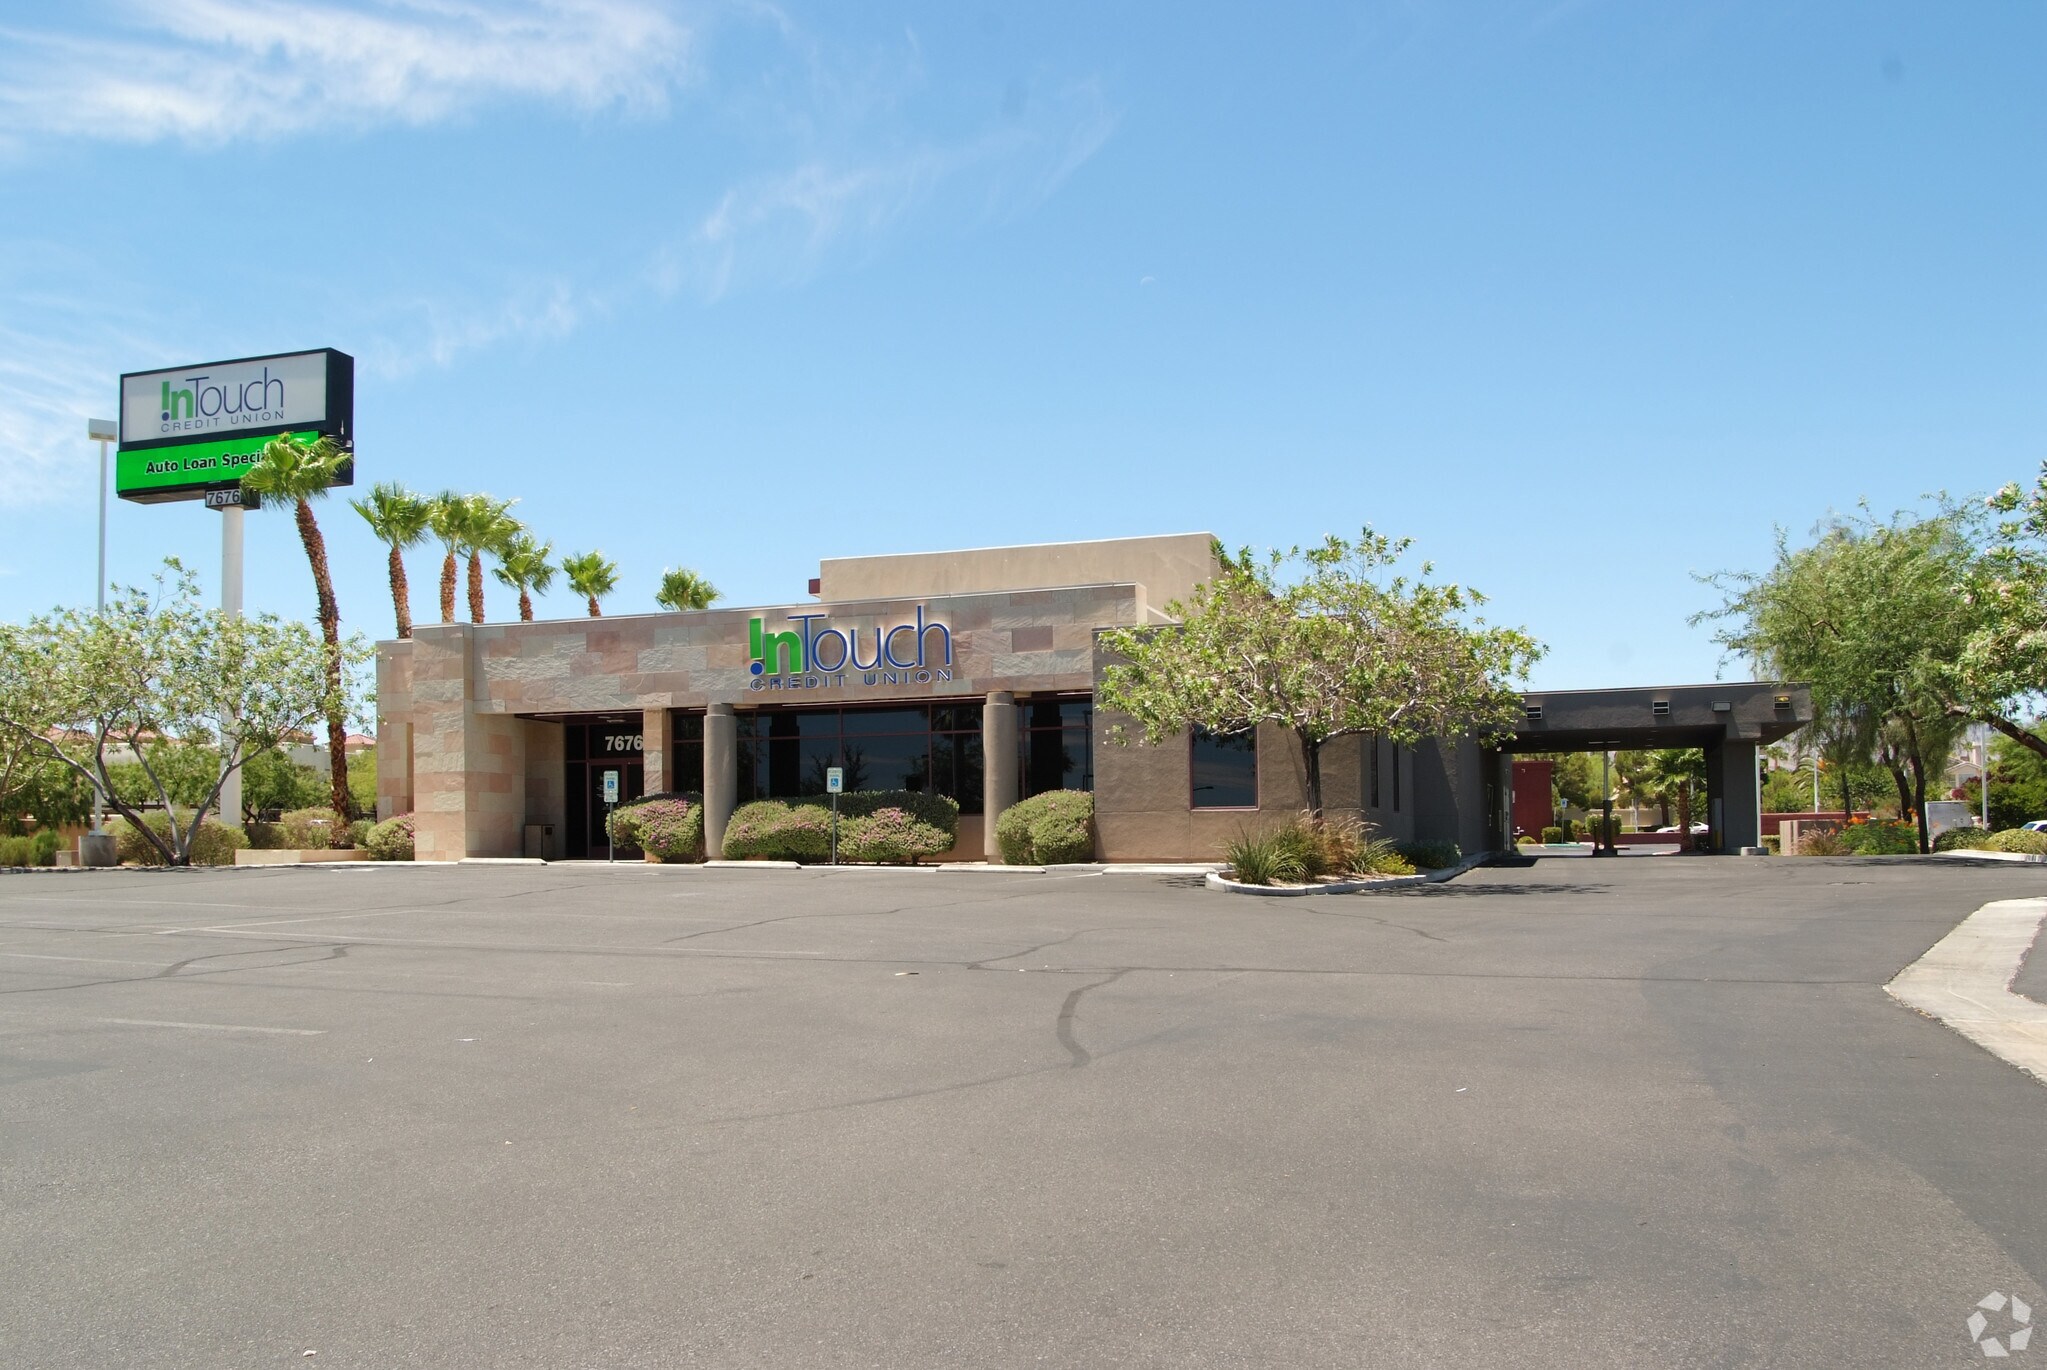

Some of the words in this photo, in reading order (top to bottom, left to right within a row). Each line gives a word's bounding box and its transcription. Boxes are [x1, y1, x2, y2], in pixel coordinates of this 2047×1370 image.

[160, 418, 220, 432] CREDIT
[230, 410, 284, 425] UNION
[145, 460, 179, 474] Auto
[183, 457, 217, 470] Loan
[207, 490, 240, 505] 7676
[750, 674, 847, 692] CREDIT
[863, 669, 951, 687] UNION
[604, 734, 643, 751] 7676
